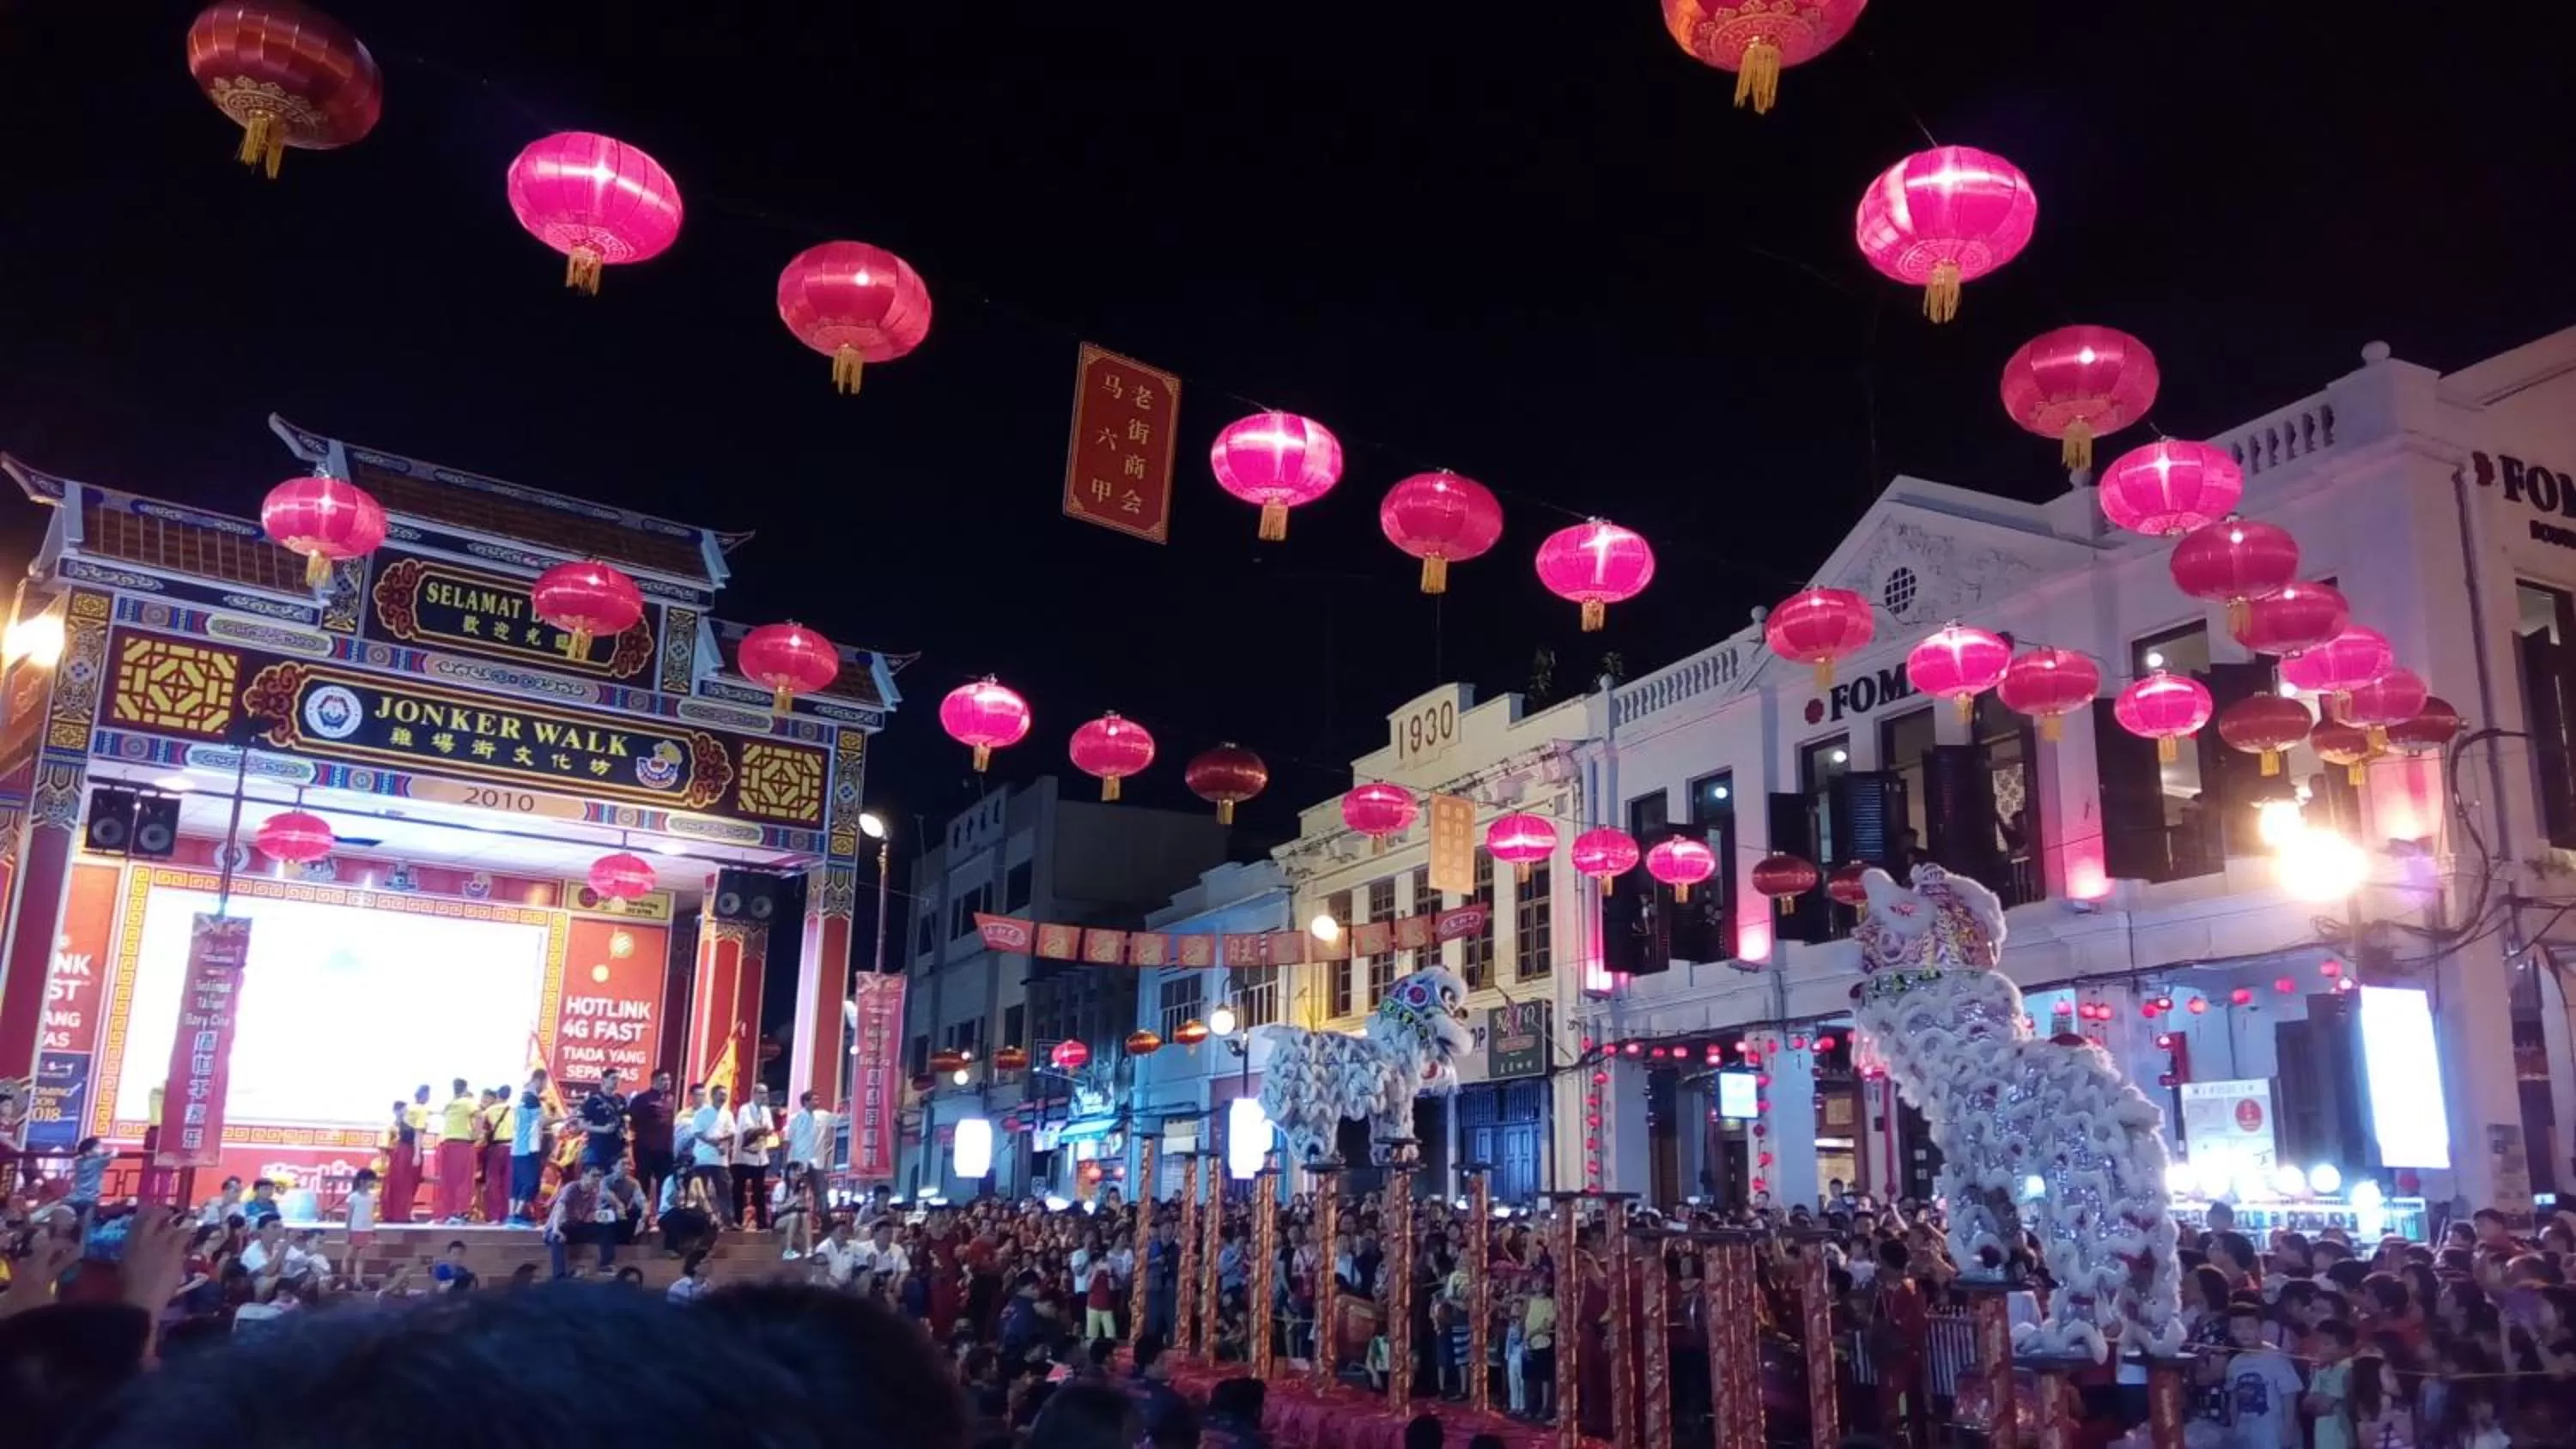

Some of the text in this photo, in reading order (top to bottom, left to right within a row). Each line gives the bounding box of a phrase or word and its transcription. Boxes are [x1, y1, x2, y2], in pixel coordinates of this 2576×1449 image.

[1091, 374, 1123, 503] 马六甲
[1120, 385, 1155, 515] 老街商会
[426, 581, 523, 619] SELAMAT
[374, 696, 521, 740] JONKER
[532, 721, 629, 757] WALK
[1399, 700, 1453, 760] 1930
[463, 786, 535, 812] 2010
[565, 996, 652, 1020] HOTLINK
[562, 1019, 646, 1042] 4G FAST
[562, 1046, 647, 1064] TIADA YANG
